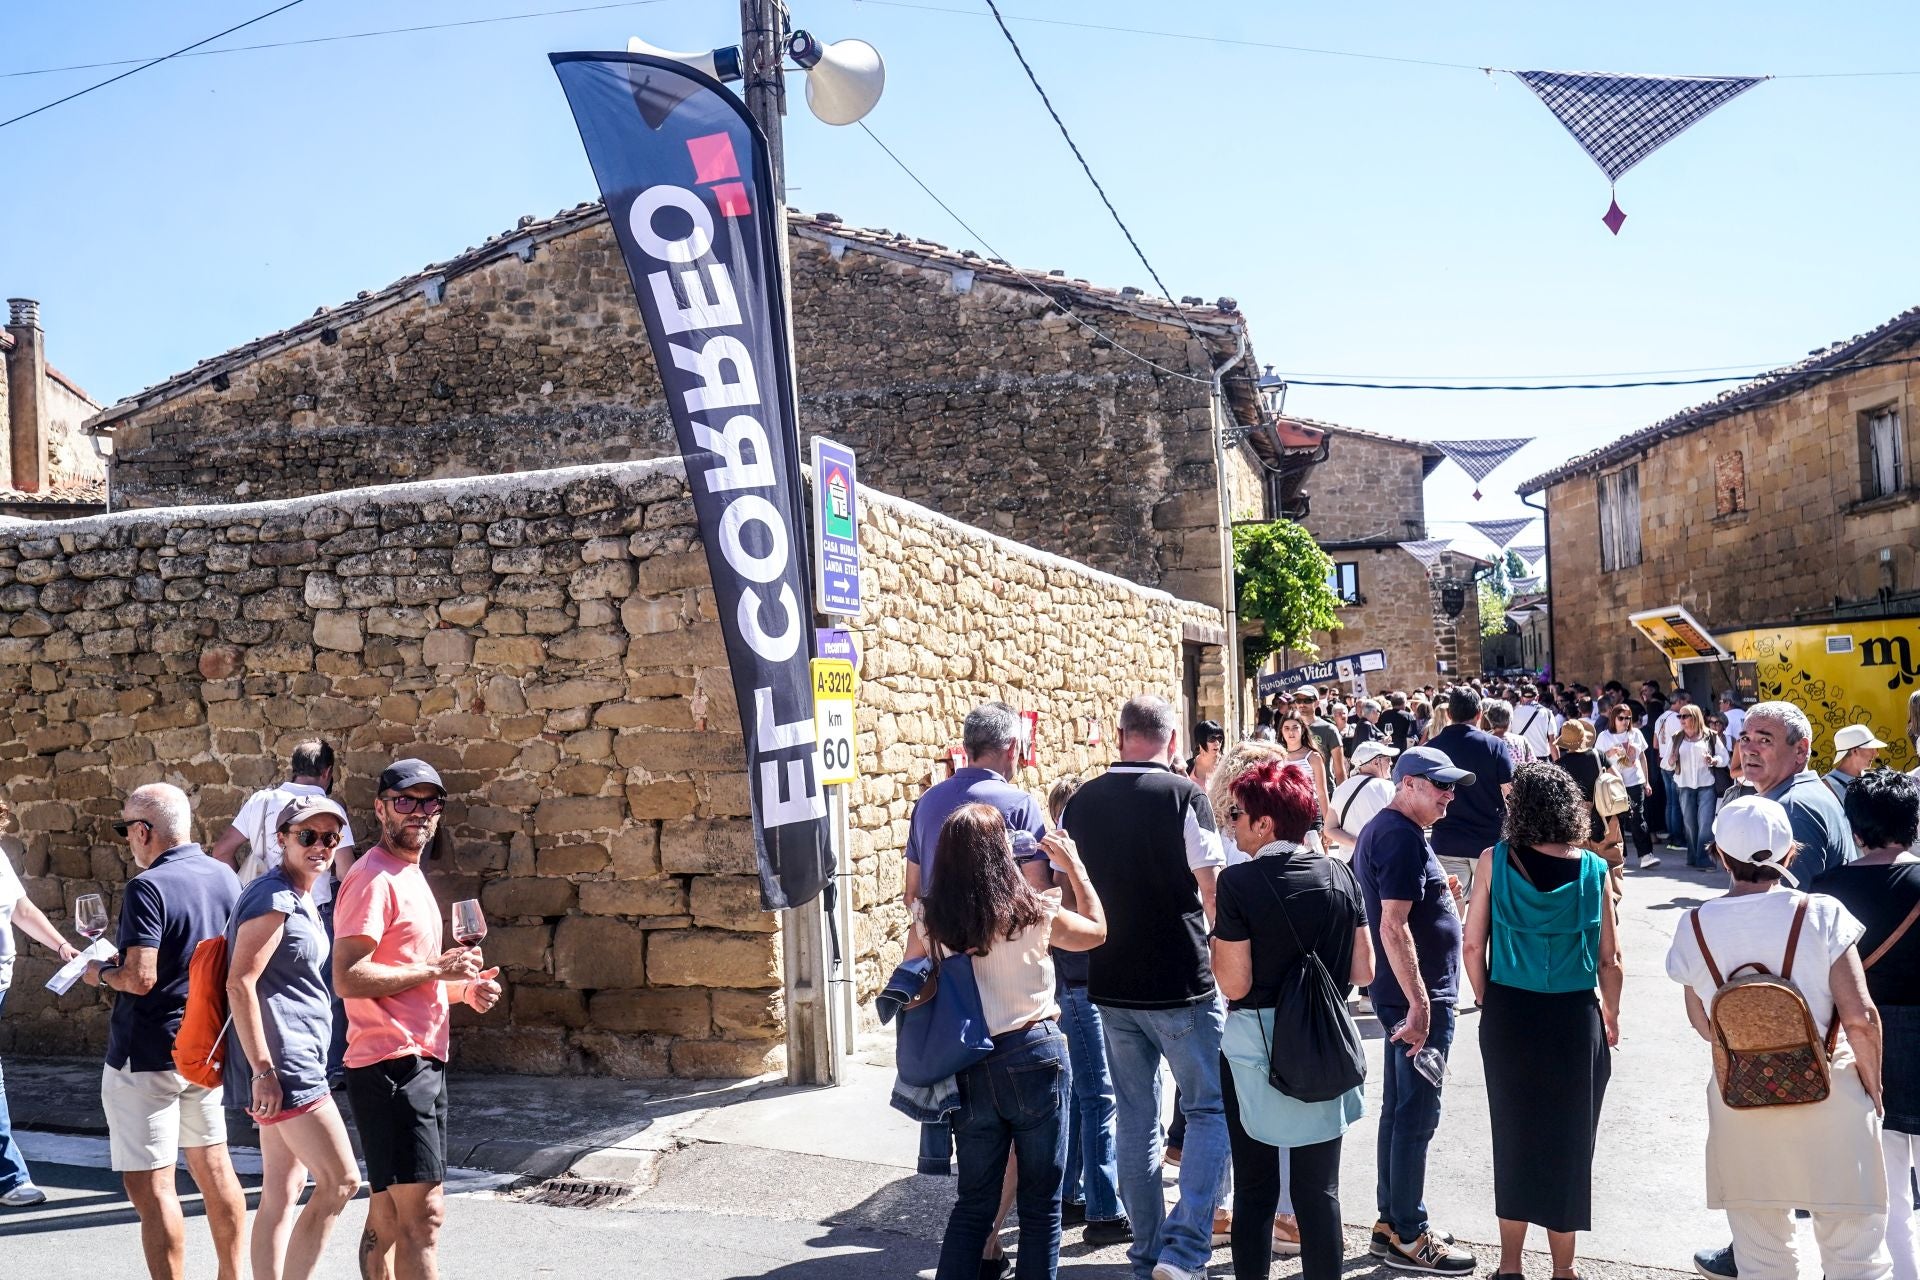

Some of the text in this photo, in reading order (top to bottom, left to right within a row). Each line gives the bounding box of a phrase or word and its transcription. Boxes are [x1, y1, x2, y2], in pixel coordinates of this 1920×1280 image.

[823, 540, 857, 557] CASA RURAL
[825, 560, 857, 576] LANDA ETXE
[1300, 661, 1334, 681] Vital
[817, 671, 852, 693] A-3212
[828, 710, 843, 727] km
[823, 737, 850, 770] 60
